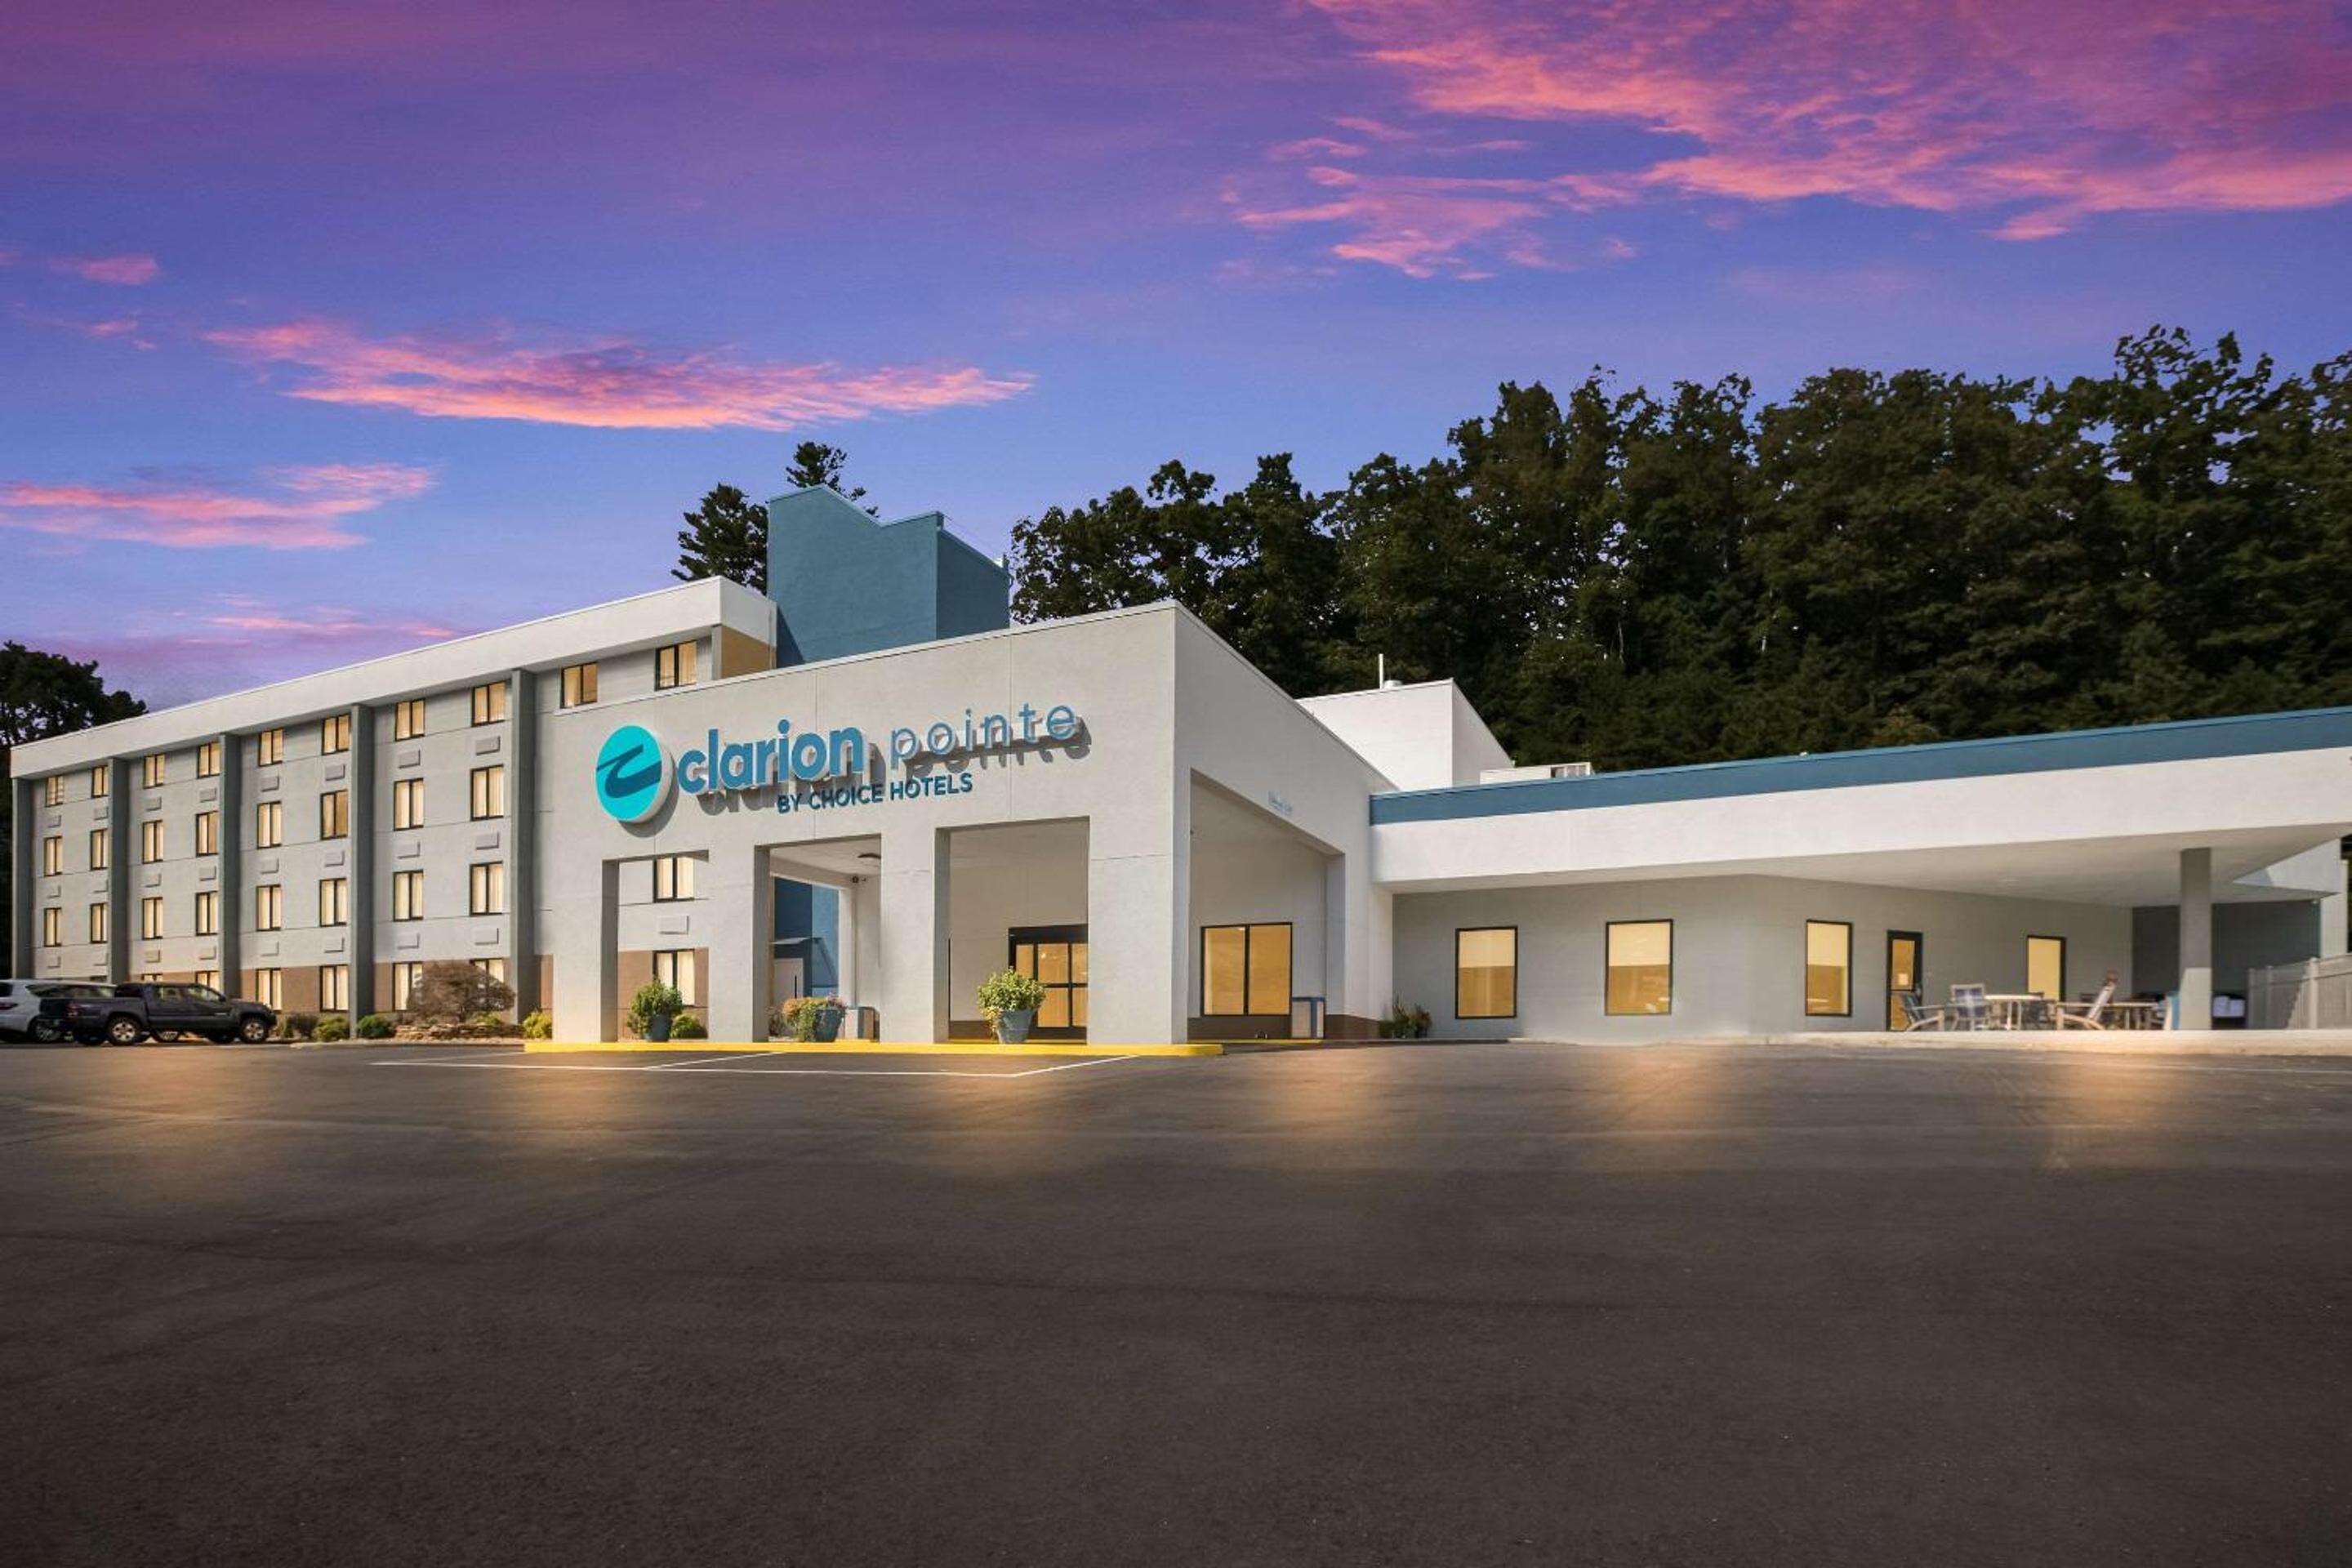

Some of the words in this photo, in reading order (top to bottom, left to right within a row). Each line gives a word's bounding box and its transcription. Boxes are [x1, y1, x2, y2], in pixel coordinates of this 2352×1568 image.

[678, 719, 863, 794] clarion
[890, 703, 1076, 770] pointe
[777, 793, 802, 813] BY
[808, 784, 884, 810] CHOICE
[890, 773, 973, 800] HOTELS
